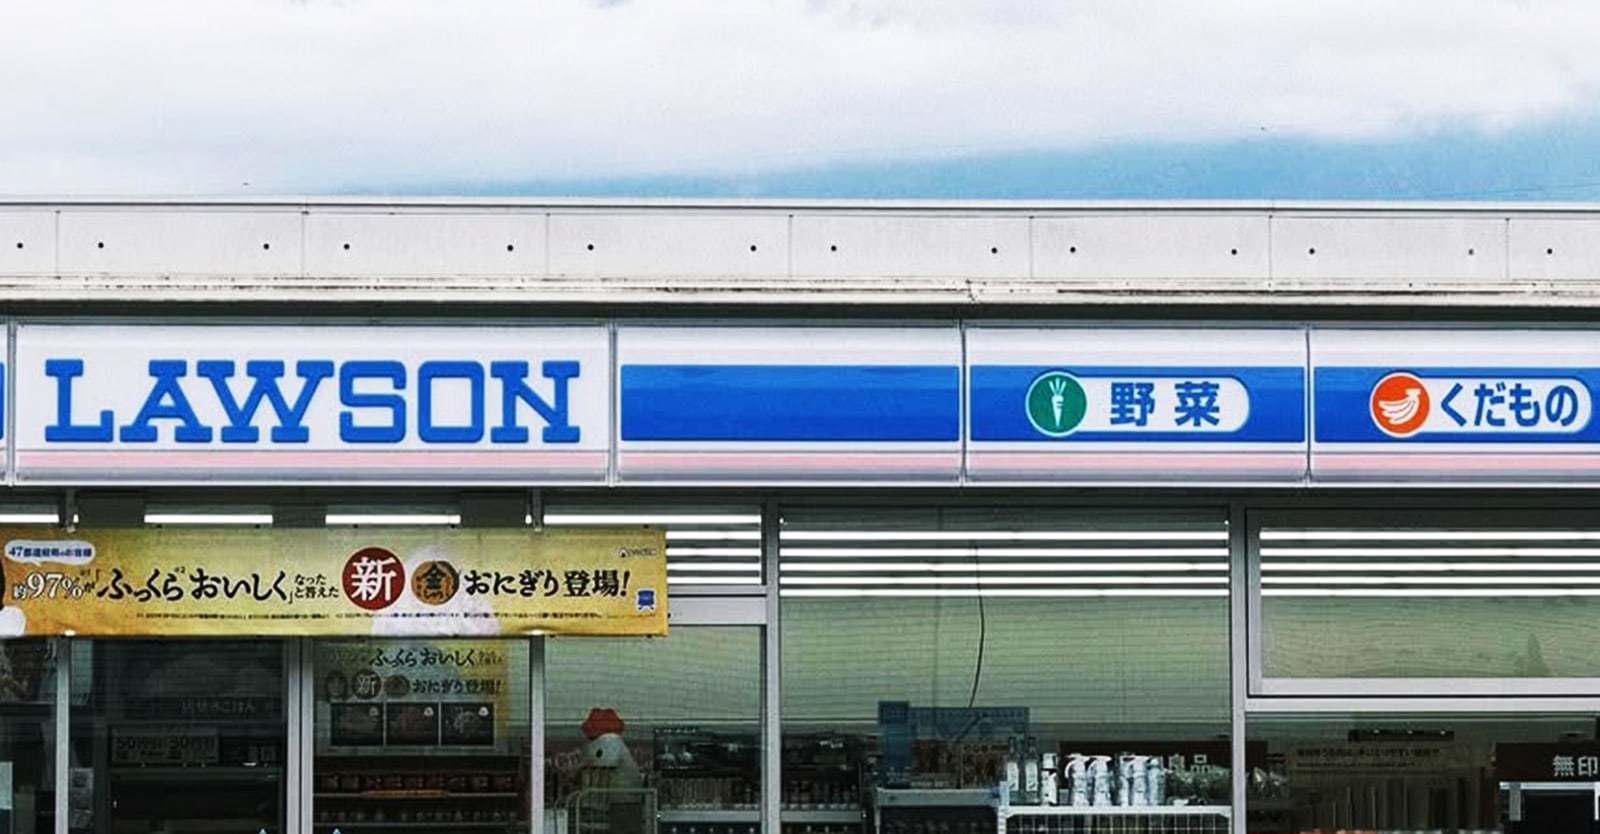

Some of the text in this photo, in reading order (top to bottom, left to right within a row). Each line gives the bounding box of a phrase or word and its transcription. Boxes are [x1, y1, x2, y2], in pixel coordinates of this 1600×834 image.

[45, 359, 581, 443] LAWSON
[1109, 381, 1221, 428] 野菜
[1440, 383, 1577, 428] くだもの
[351, 557, 397, 602] 新
[356, 674, 377, 696] 新
[1552, 755, 1599, 777] 無印
